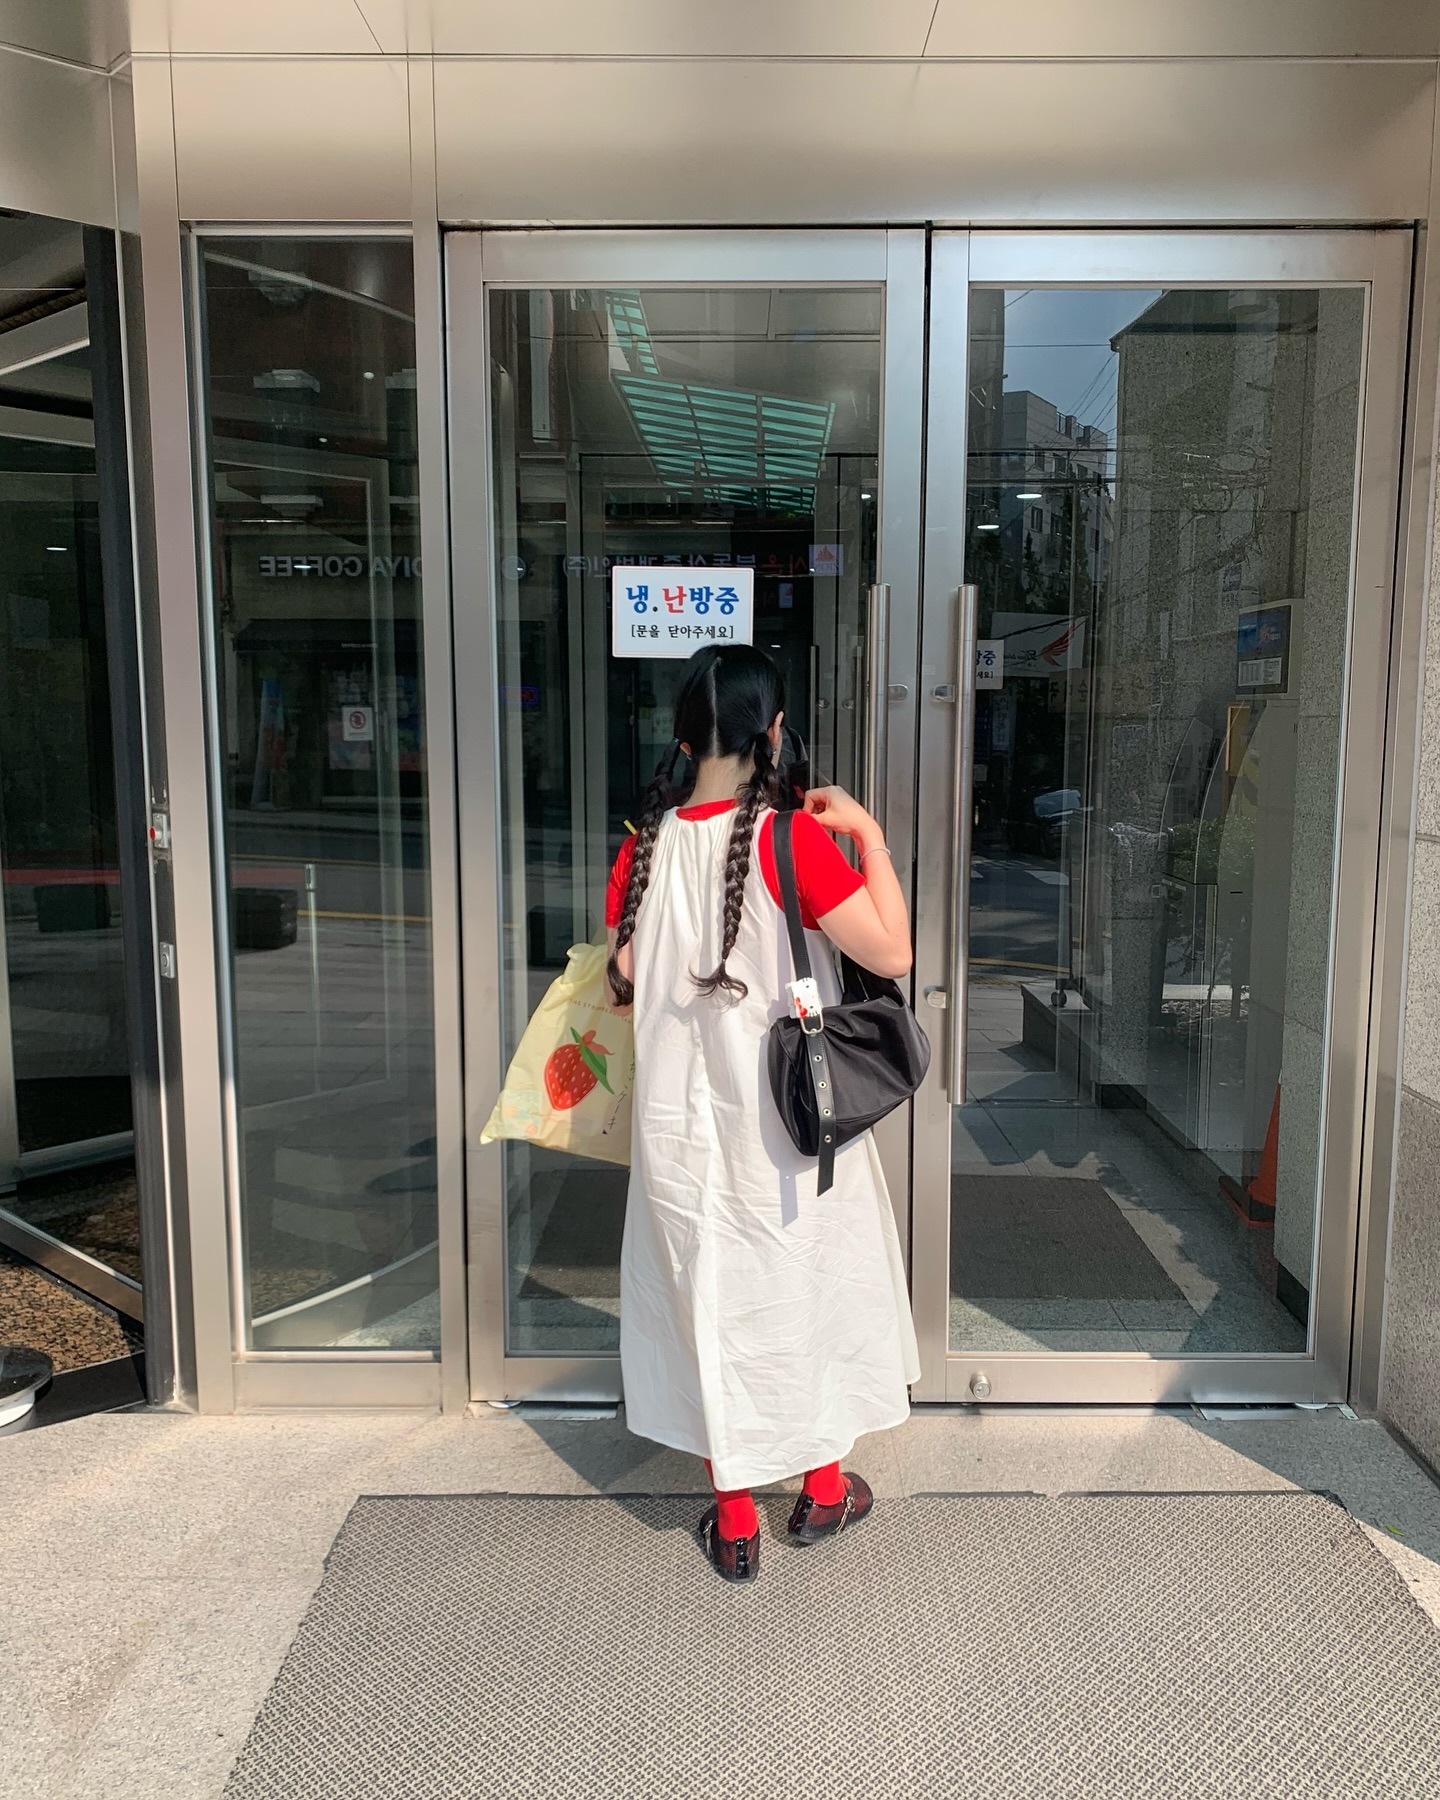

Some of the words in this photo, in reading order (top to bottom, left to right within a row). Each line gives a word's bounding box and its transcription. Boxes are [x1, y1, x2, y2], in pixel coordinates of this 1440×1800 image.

[625, 585, 740, 615] 냉.난방중
[631, 624, 660, 638] [문을
[668, 625, 734, 639] 닫아주세요]
